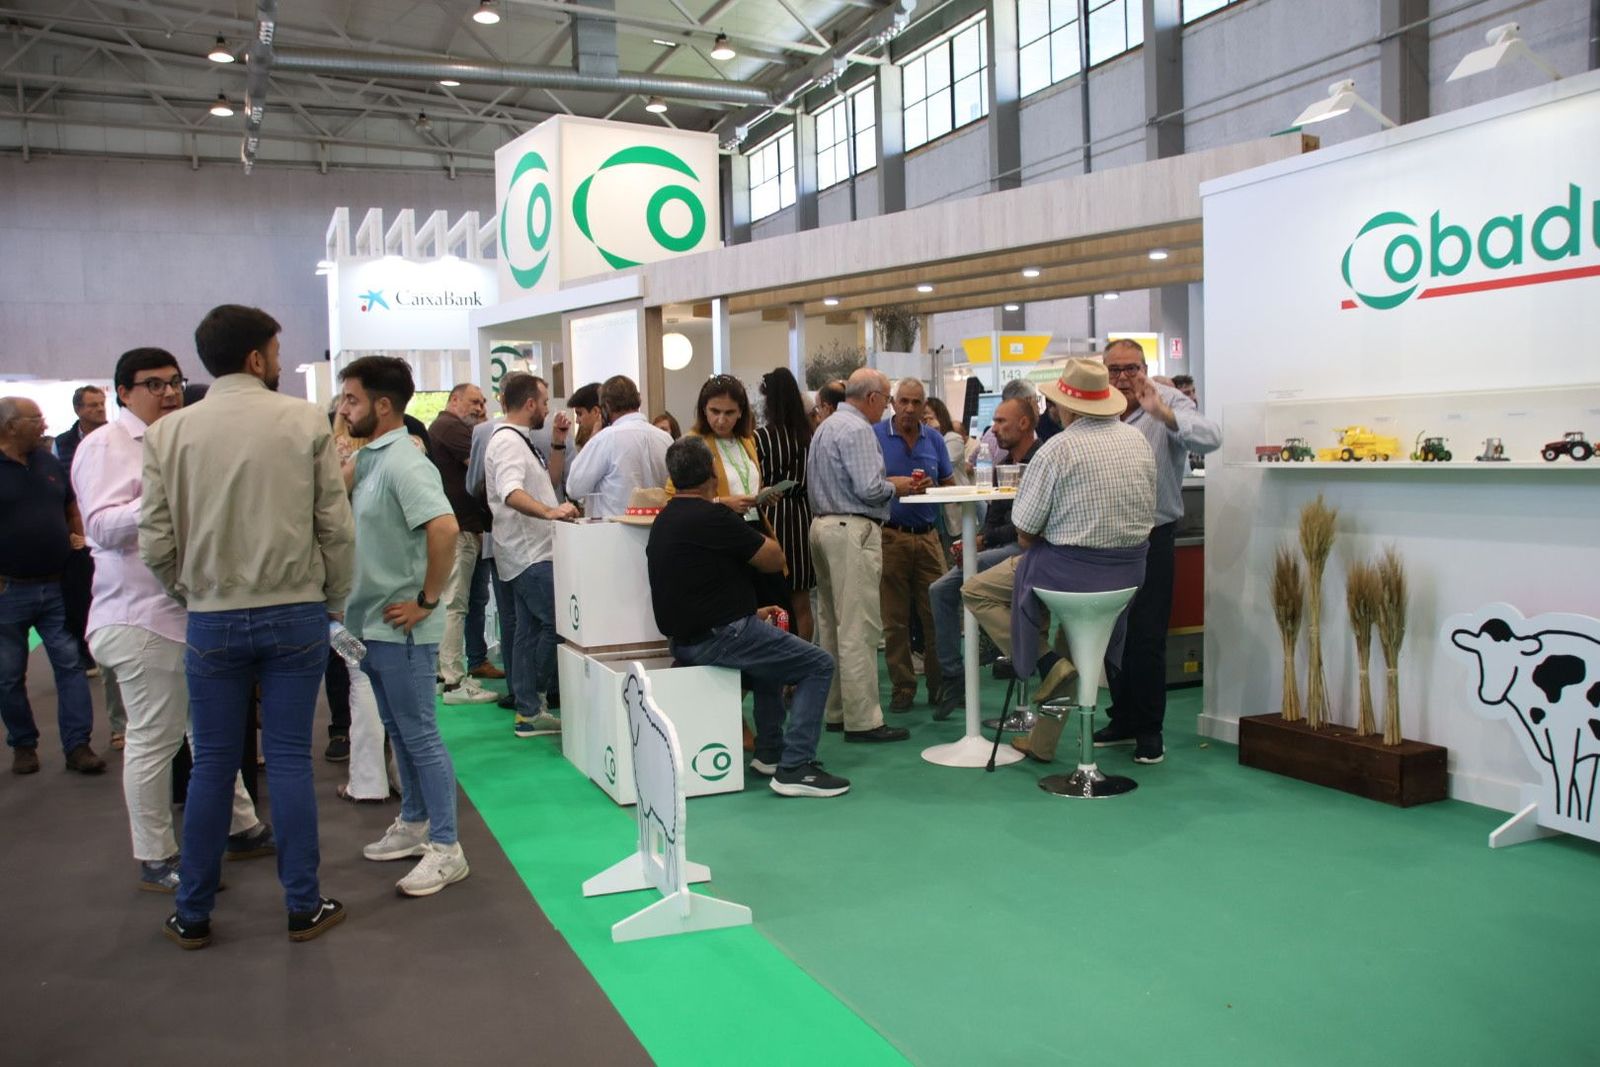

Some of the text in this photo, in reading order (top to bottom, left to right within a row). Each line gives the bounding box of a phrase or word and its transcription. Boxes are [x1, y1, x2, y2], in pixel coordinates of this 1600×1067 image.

[1342, 183, 1600, 310] Cobad
[395, 290, 483, 306] CaixaBank
[1002, 369, 1021, 381] 143
